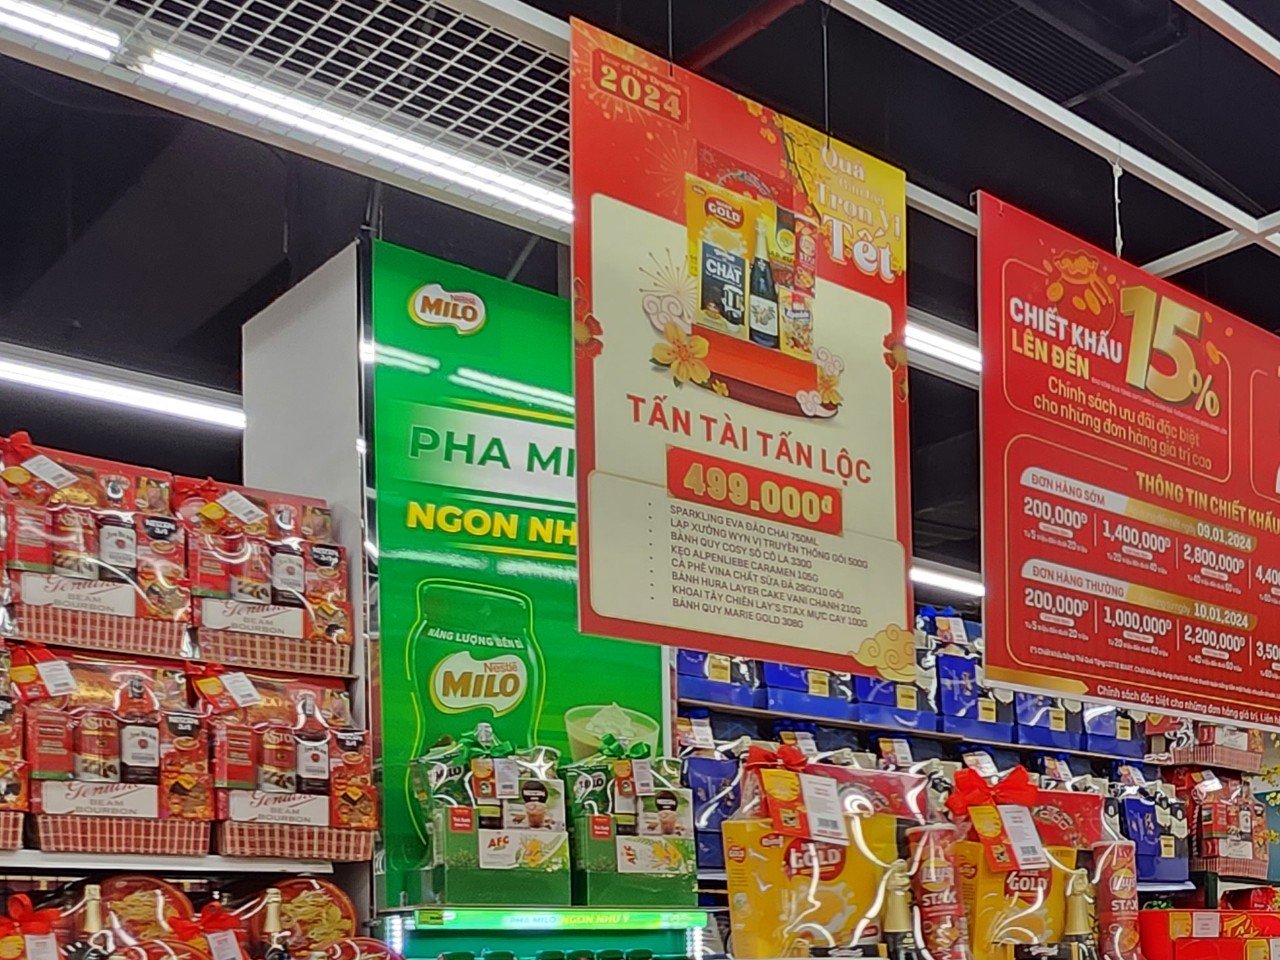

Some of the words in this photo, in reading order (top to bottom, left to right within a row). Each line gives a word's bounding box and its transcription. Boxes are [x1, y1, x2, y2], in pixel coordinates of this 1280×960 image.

[600, 65, 681, 120] 2024
[821, 145, 865, 181] Quà
[707, 203, 741, 222] GOLD
[821, 213, 895, 284] Tết
[419, 294, 479, 324] MILO
[1009, 296, 1069, 342] CHIẾT
[1070, 321, 1123, 365] KHẤU
[1010, 327, 1049, 365] LÊN
[1051, 345, 1091, 381] ĐẾN
[1119, 284, 1221, 417] 15%
[1048, 375, 1086, 406] Chính
[1087, 393, 1116, 419] sách
[1118, 406, 1136, 424] ưu
[1136, 405, 1156, 429] đãi
[1156, 417, 1178, 439] đặc
[1179, 421, 1200, 447] biệt
[626, 393, 691, 437] TẤN
[700, 413, 748, 452] TÀI
[756, 431, 813, 470] TẤN
[821, 448, 872, 486] LỘC
[1033, 393, 1058, 417] cho
[1060, 403, 1101, 434] những
[1102, 415, 1126, 440] đơn
[1128, 424, 1157, 455] hàng
[1159, 442, 1177, 466] giá
[1178, 446, 1193, 467] trị
[1193, 452, 1212, 471] cao
[408, 424, 513, 471] PHA
[526, 442, 576, 479] MI
[683, 462, 833, 523] 499.000đ
[1135, 470, 1184, 503] THÔNG
[1186, 487, 1208, 510] TIN
[1209, 493, 1246, 522] CHIẾT
[1247, 507, 1280, 536] KHẤU
[406, 501, 520, 539] NGON
[528, 516, 577, 546] NH
[670, 505, 724, 525] SPARKLING
[726, 517, 744, 529] EVA
[767, 526, 789, 539] CHAI
[1031, 473, 1055, 490] ĐƠN
[1055, 479, 1084, 499] HÀNG
[1084, 487, 1106, 506] SỚM
[1196, 521, 1253, 551] 09.01.2024
[671, 545, 692, 558] KẸO
[693, 549, 750, 569] ALPENLIEBE
[751, 561, 796, 578] CARAMEN
[797, 570, 819, 583] 105G
[52, 599, 115, 613] BOURBON
[701, 578, 728, 591] HURA
[729, 583, 759, 596] LAYER
[760, 589, 785, 600] CAKE
[786, 594, 808, 605] VANI
[809, 598, 840, 611] CHANH
[841, 604, 861, 615] 210G
[702, 604, 722, 616] QUY
[724, 608, 754, 621] MARIE
[755, 613, 781, 625] GOLD
[1031, 565, 1055, 582] ĐƠN
[1055, 572, 1084, 590] HÀNG
[1085, 578, 1125, 599] THƯỜNG
[1193, 602, 1250, 629] 10.01.2024
[454, 630, 494, 648] LƯỢNG
[441, 670, 521, 699] MILO
[483, 661, 518, 674] Nestlé
[75, 805, 137, 815] BOURBON
[89, 798, 125, 807] BEAM
[257, 814, 311, 823] BOURBON
[269, 807, 300, 815] BEAM
[488, 835, 509, 848] AFC
[1010, 876, 1047, 891] GOLD
